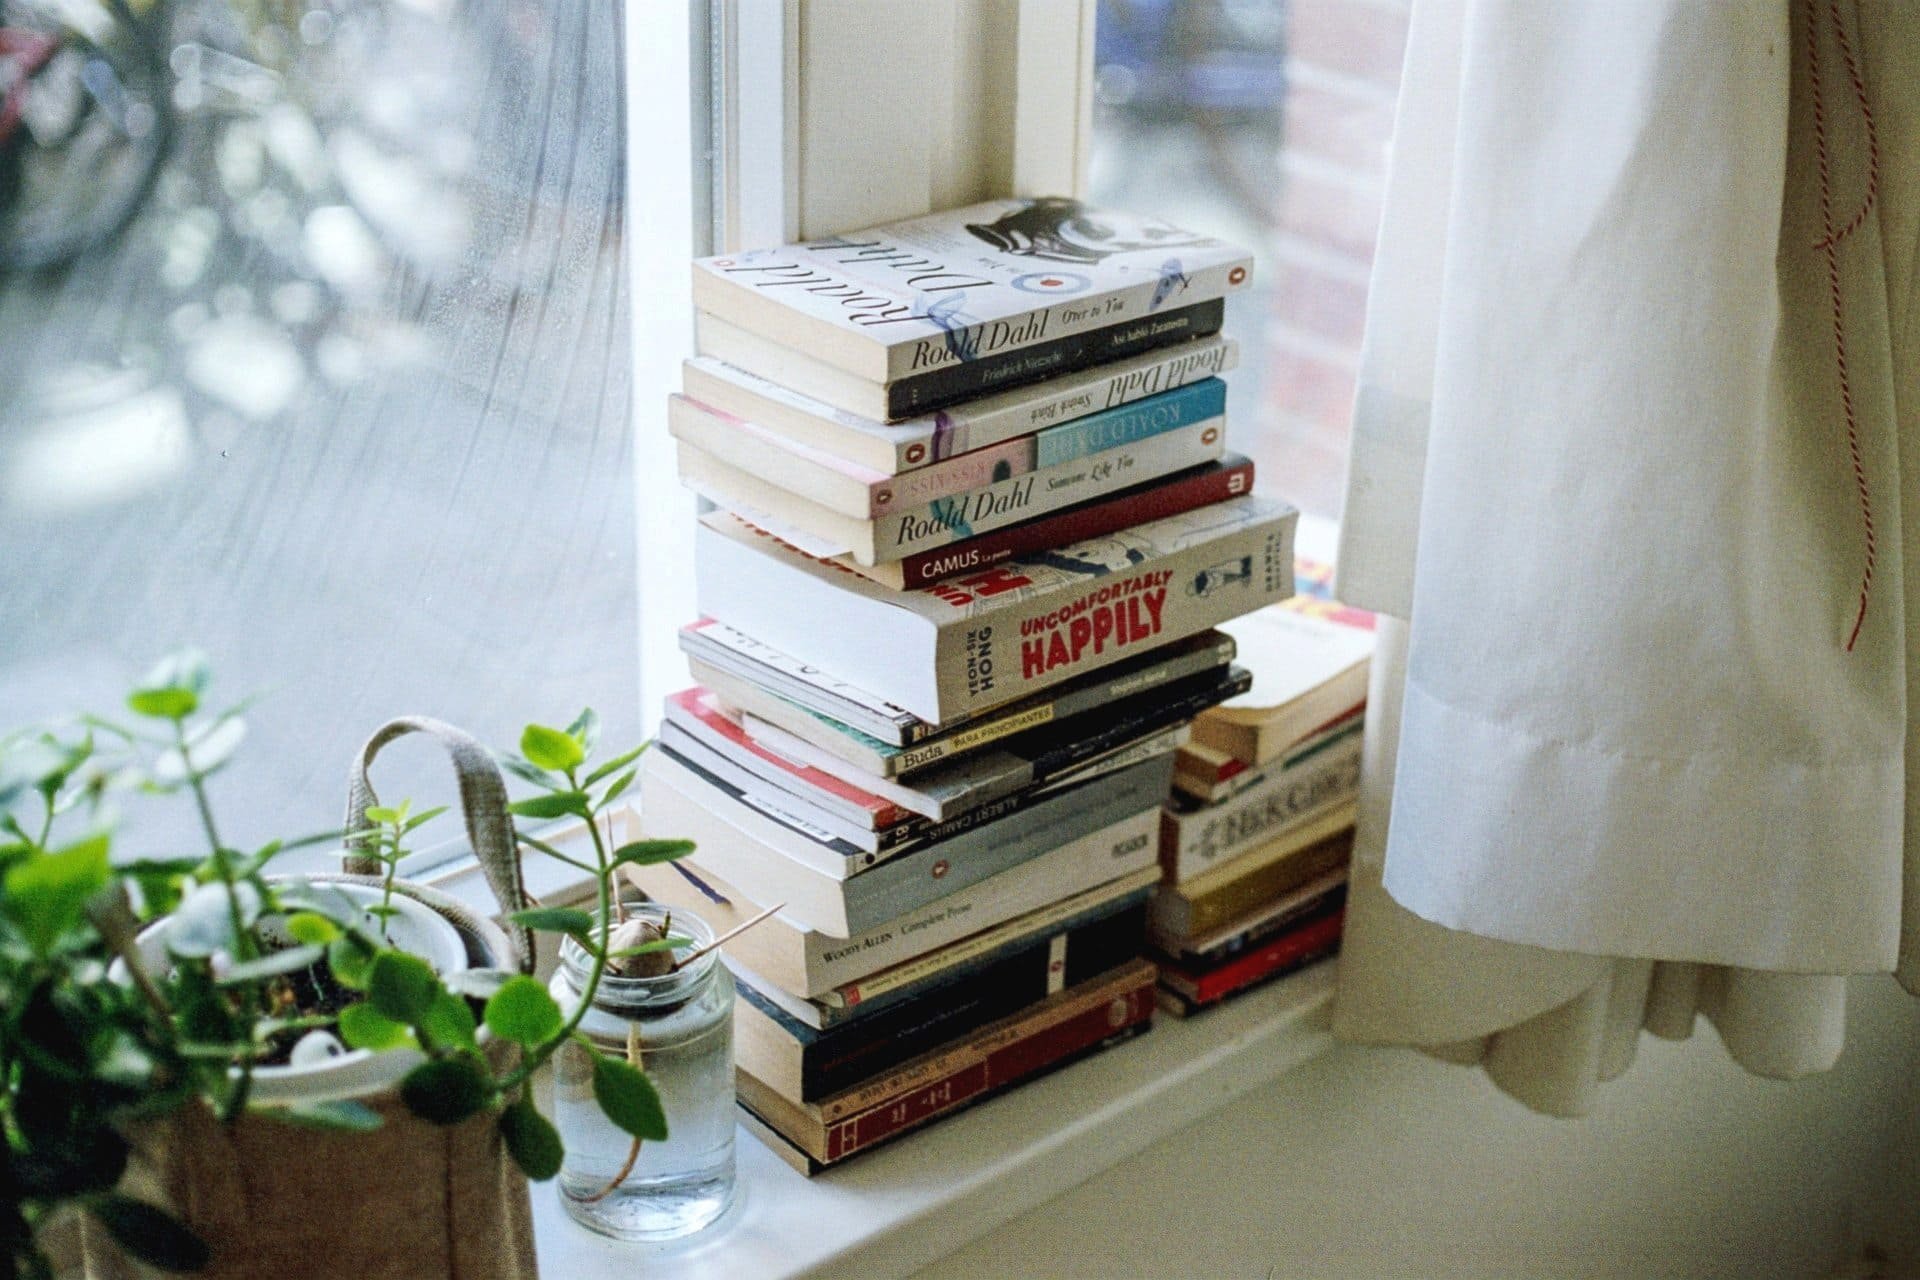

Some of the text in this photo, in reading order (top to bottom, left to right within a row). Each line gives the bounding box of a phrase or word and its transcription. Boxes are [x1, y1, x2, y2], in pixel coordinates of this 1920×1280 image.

[911, 309, 1051, 370] Roald Dahl
[1062, 306, 1087, 325] Over
[1105, 297, 1125, 315] You
[1105, 345, 1228, 409] Roald Dahl
[1111, 402, 1181, 437] ROALD
[895, 495, 970, 547] Roald
[973, 477, 1035, 522] Dahl
[921, 550, 980, 579] CAMUS
[1020, 569, 1174, 637] UNCOMFORTABLY
[966, 628, 978, 698] YEON-SIK
[978, 626, 994, 691] HONG
[1021, 588, 1167, 681] HAPPILY
[904, 745, 944, 768] Buda
[863, 932, 893, 950] ALLEN
